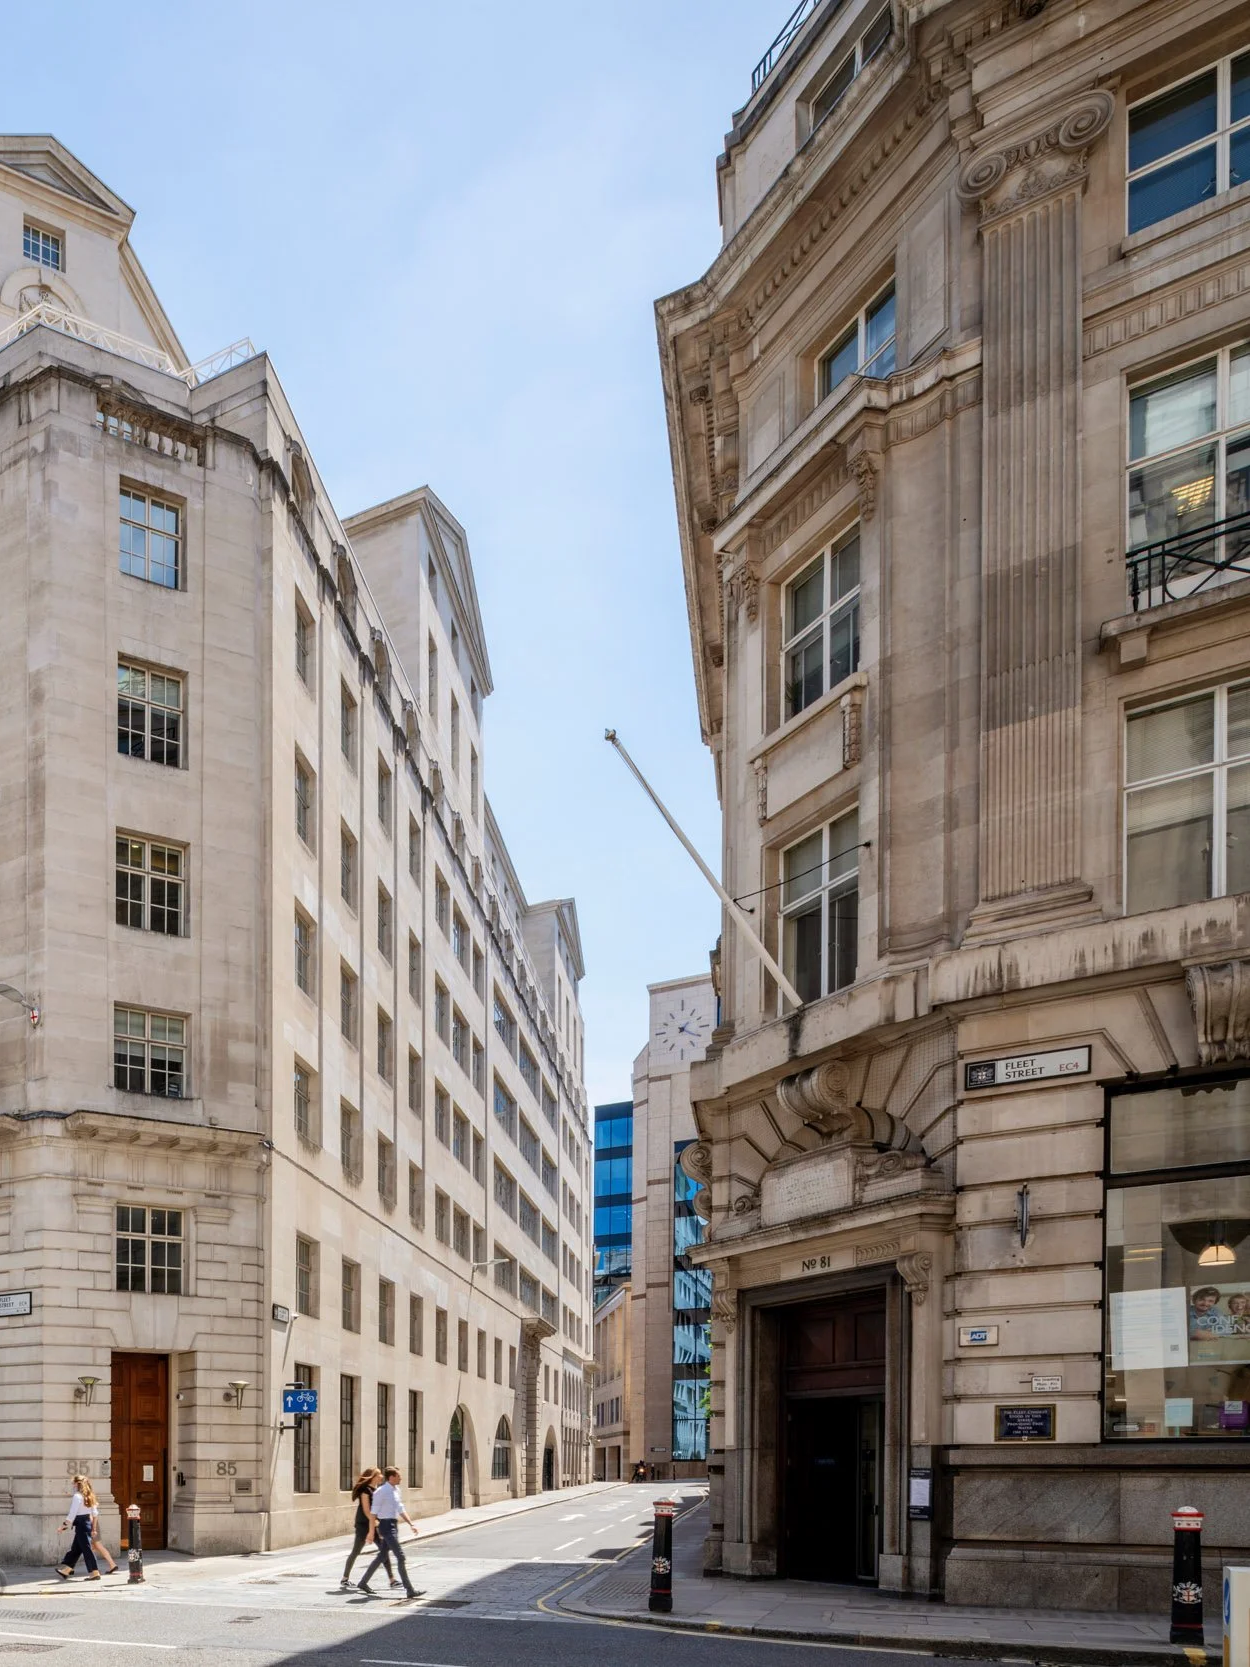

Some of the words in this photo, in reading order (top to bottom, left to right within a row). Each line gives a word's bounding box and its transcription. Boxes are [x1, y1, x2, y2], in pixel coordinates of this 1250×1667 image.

[1005, 1059, 1037, 1070] FLEET
[1059, 1062, 1080, 1072] EC4
[1005, 1067, 1045, 1079] STREET
[820, 1255, 831, 1268] 81
[971, 1332, 987, 1340] ADT
[66, 1461, 90, 1476] 85
[216, 1461, 237, 1476] 85
